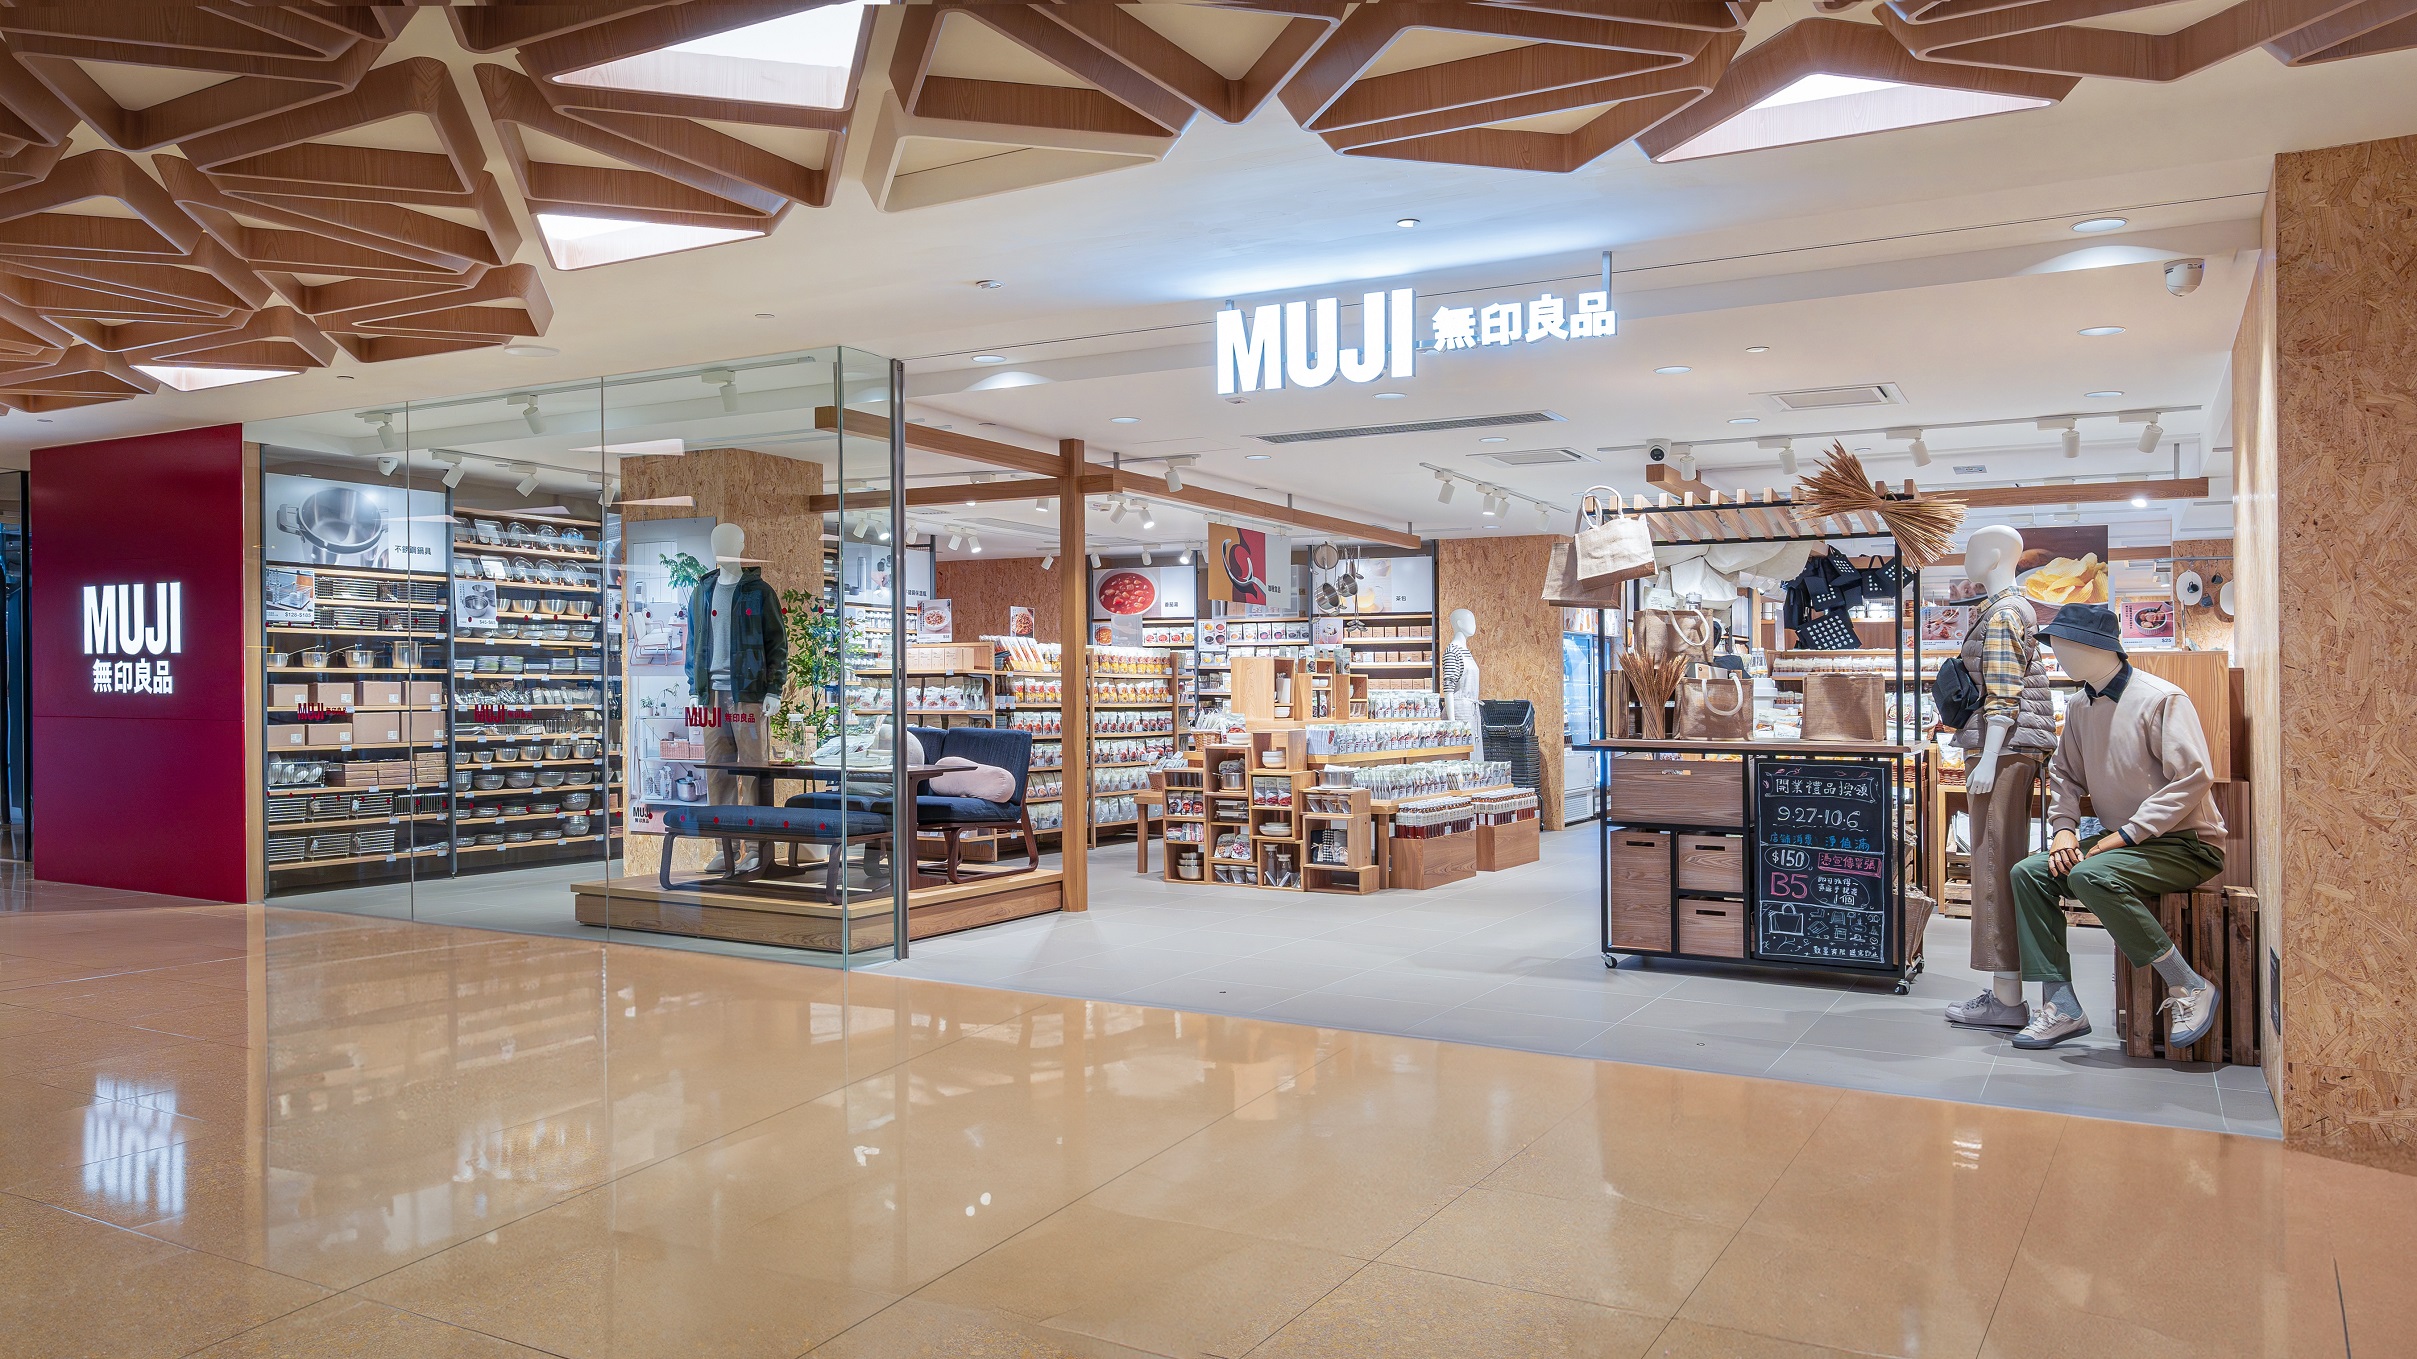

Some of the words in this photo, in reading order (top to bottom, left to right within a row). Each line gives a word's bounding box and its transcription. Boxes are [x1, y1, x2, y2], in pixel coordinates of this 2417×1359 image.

[1216, 288, 1416, 395] MUJI
[1432, 291, 1618, 352] 無印良品
[83, 581, 181, 655] MUJI
[92, 658, 173, 694] 無印良品
[297, 702, 324, 720] MUJI
[474, 704, 505, 723] MUJI
[684, 706, 722, 728] MUJI
[724, 712, 756, 723] 無印良品
[1776, 779, 1869, 797] 開業禮品換領
[1777, 806, 1861, 828] 9.27-10.6
[1771, 849, 1806, 868] $150
[1770, 872, 1808, 899] B5
